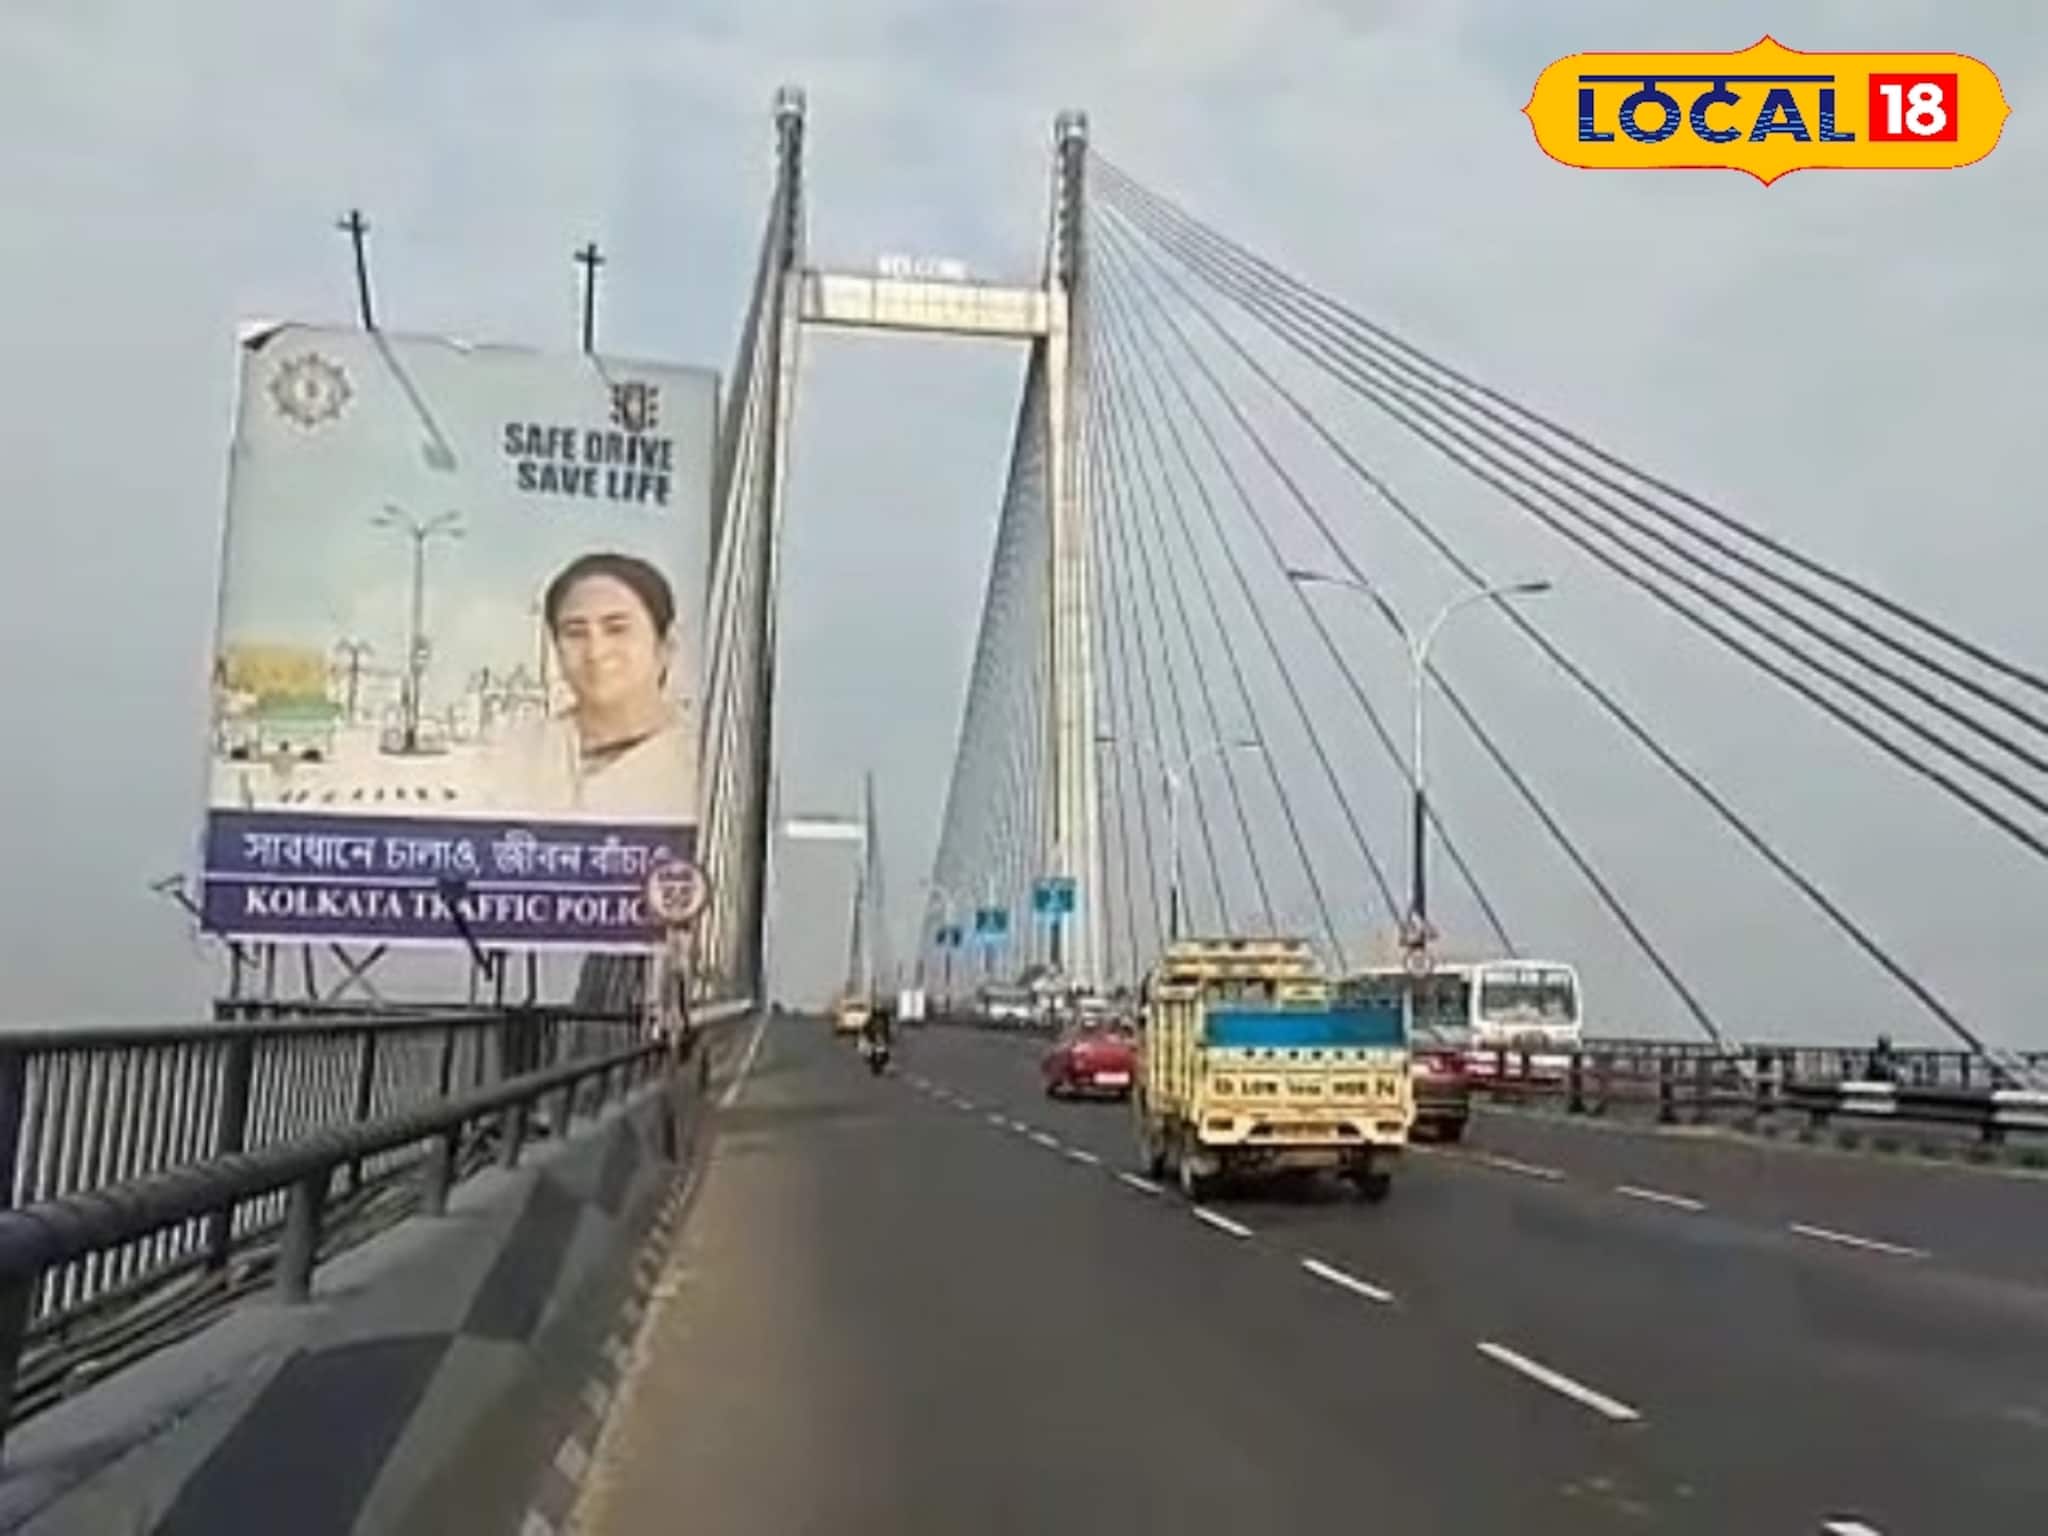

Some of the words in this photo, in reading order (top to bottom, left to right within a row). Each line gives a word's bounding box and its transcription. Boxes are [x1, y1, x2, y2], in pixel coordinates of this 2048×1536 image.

[504, 422, 576, 460] SAFE
[584, 431, 673, 471] DRIVE
[516, 461, 598, 498] SAVE
[607, 469, 669, 506] LIFE
[243, 832, 376, 871] সাবধানে
[491, 828, 582, 876] জীবন
[247, 885, 403, 918] KOLKATA
[556, 896, 651, 923] POLIC
